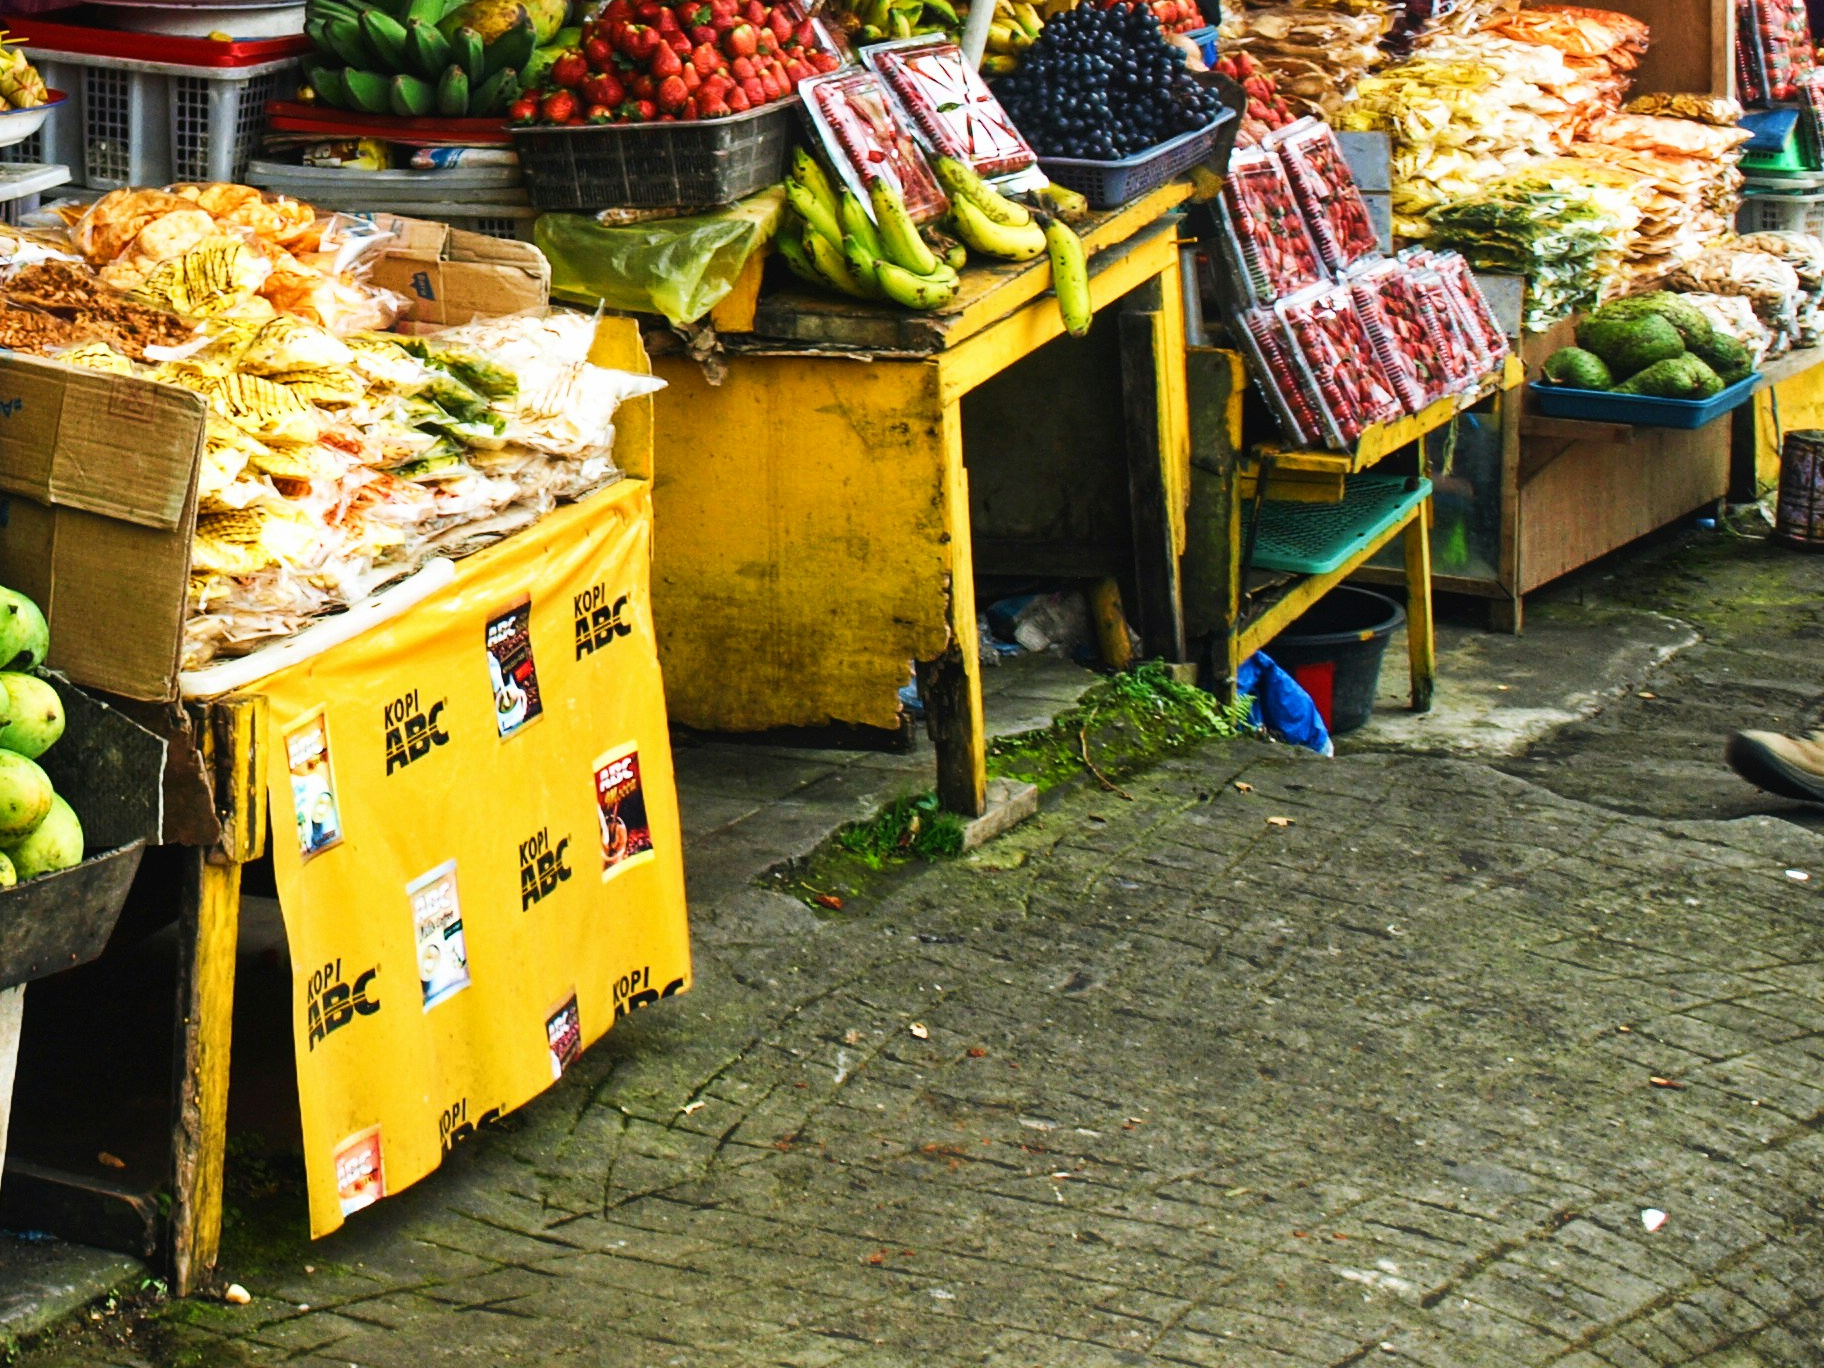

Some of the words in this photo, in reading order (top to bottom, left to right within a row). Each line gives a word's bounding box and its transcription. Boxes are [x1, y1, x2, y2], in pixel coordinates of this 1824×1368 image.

[574, 583, 606, 618] KOPI
[576, 595, 632, 661] ABC
[385, 689, 418, 729] KOPI
[386, 701, 450, 777] ABC
[599, 756, 634, 793] ABC
[519, 827, 549, 868] KOPI
[521, 838, 572, 912] ABC
[308, 958, 341, 1003] KOPI
[613, 967, 650, 1005] KOPI
[309, 968, 380, 1052] ABC
